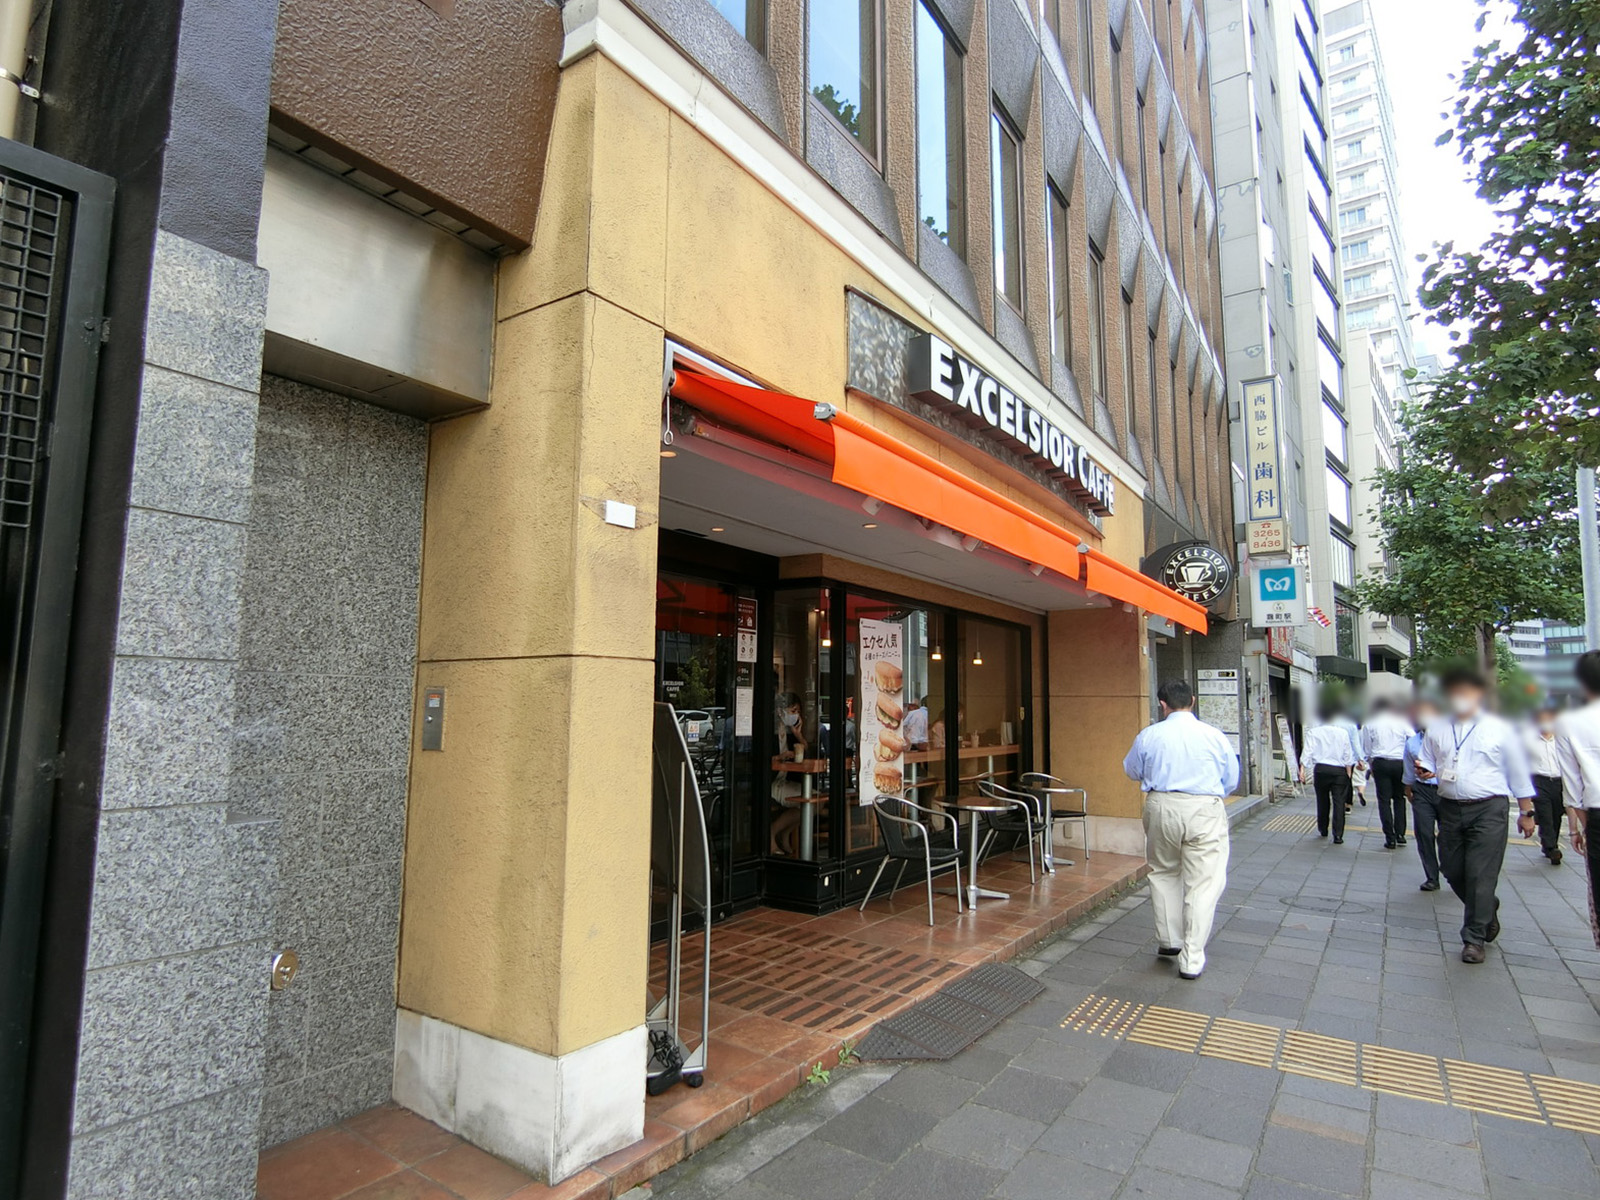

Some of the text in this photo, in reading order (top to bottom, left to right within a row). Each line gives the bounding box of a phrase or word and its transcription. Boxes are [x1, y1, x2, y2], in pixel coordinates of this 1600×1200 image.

[930, 333, 1076, 479] EXCELSIOR
[1253, 529, 1281, 538] 3265
[1253, 539, 1282, 548] 8436
[1166, 548, 1226, 575] EXCELSIOR
[862, 632, 898, 650] エクセ人気
